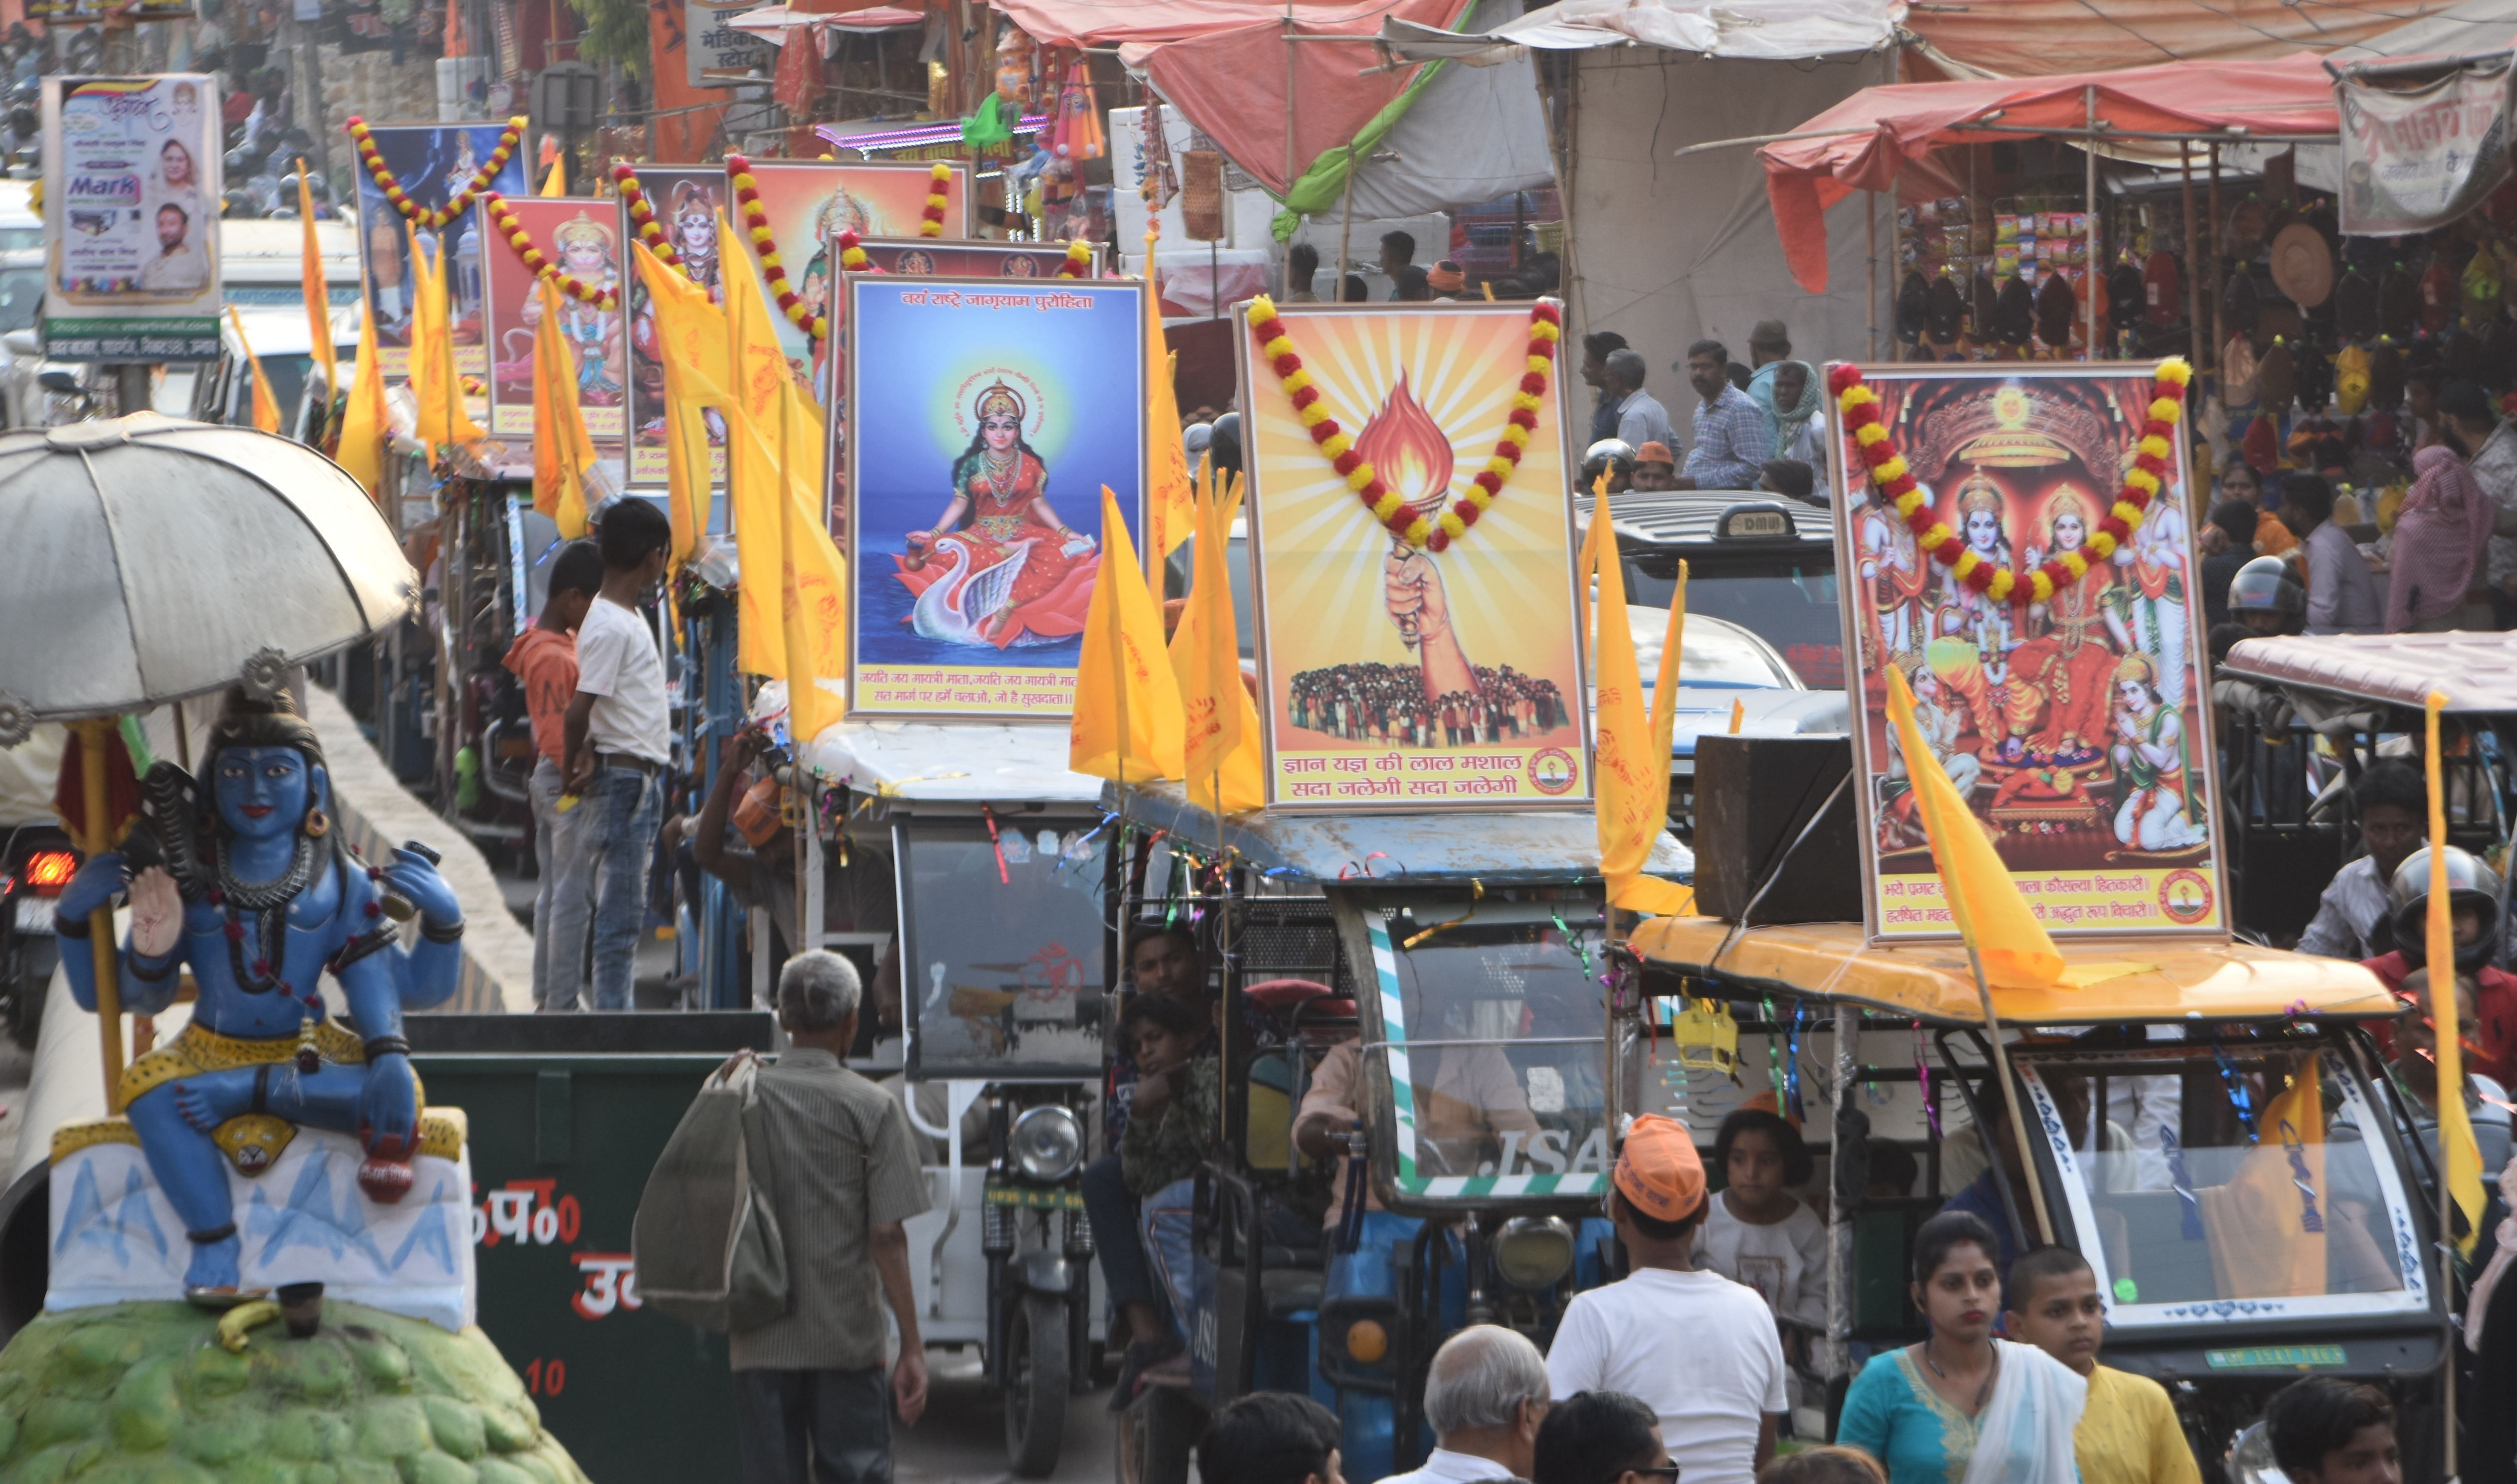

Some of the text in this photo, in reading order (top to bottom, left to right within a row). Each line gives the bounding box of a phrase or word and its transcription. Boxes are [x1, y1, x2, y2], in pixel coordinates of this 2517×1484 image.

[68, 176, 136, 196] Mark
[901, 289, 1093, 312] वयं राष्ट्रे जागृयाम पुरोहिता
[859, 669, 888, 684] जयति
[891, 672, 908, 684] जय
[912, 670, 943, 685] गायत्री
[1005, 673, 1021, 685] जय
[1025, 672, 1056, 687] गायत्री
[874, 689, 891, 702] सत
[894, 687, 916, 702] मार्ग
[919, 691, 932, 702] पर
[935, 688, 951, 703] हमें
[954, 689, 991, 704] चलाओ,
[995, 691, 1007, 703] जो
[1010, 689, 1018, 703] है
[1282, 752, 1523, 774] ज्ञान यज्ञ की लाल मशाल
[1290, 775, 1517, 797] सदा जलेगी सदा जलेगी
[1884, 880, 1904, 896] भये
[1907, 882, 1935, 899] प्रगट
[2044, 875, 2091, 894] कौसल्या
[1886, 905, 1921, 923] हरषित
[2086, 906, 2107, 919] रूप
